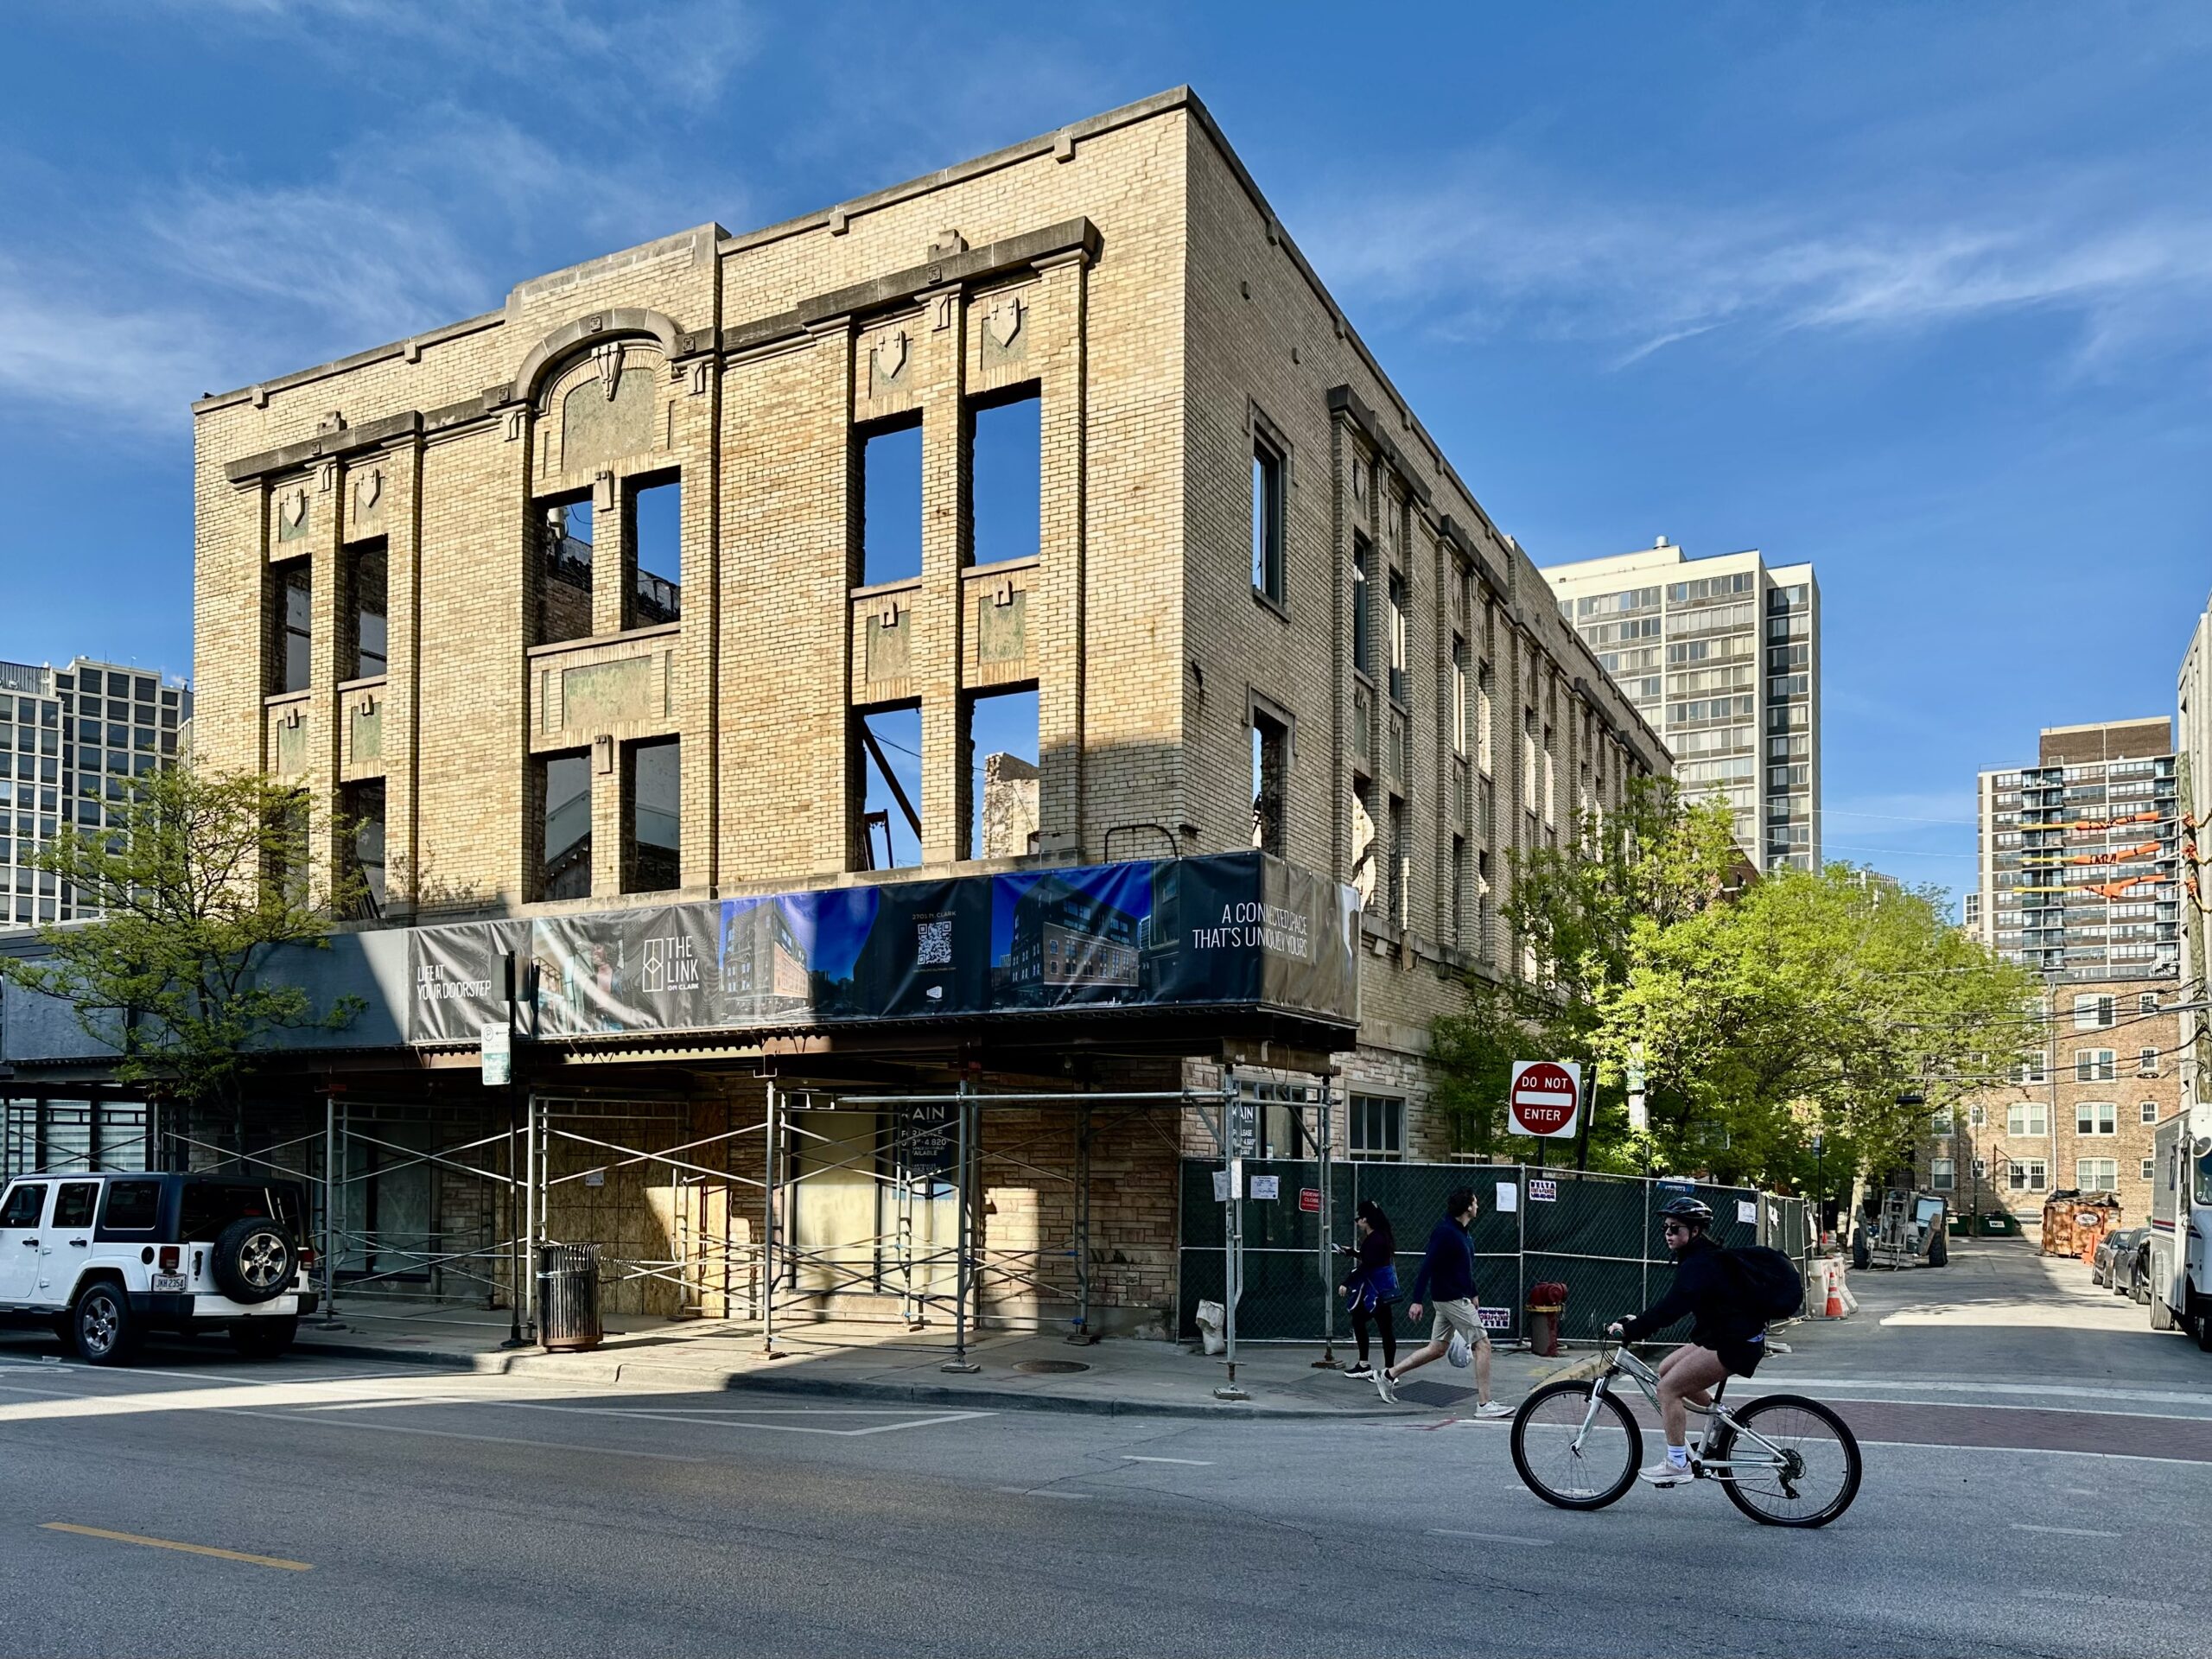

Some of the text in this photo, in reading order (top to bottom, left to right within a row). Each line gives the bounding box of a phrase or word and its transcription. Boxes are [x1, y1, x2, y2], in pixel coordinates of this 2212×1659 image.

[1222, 902, 1307, 936] A CONNECTED SPACE
[666, 936, 693, 959] THE
[1192, 926, 1307, 958] THAT'S UNIQUELY YOURS
[417, 964, 445, 982] LIFE AT
[667, 958, 699, 983] LINK
[416, 980, 492, 1001] YOUR DOORSTEP
[1522, 1076, 1568, 1089] DO NOT
[1524, 1108, 1560, 1121] ENTER
[168, 1278, 184, 1287] 2354
